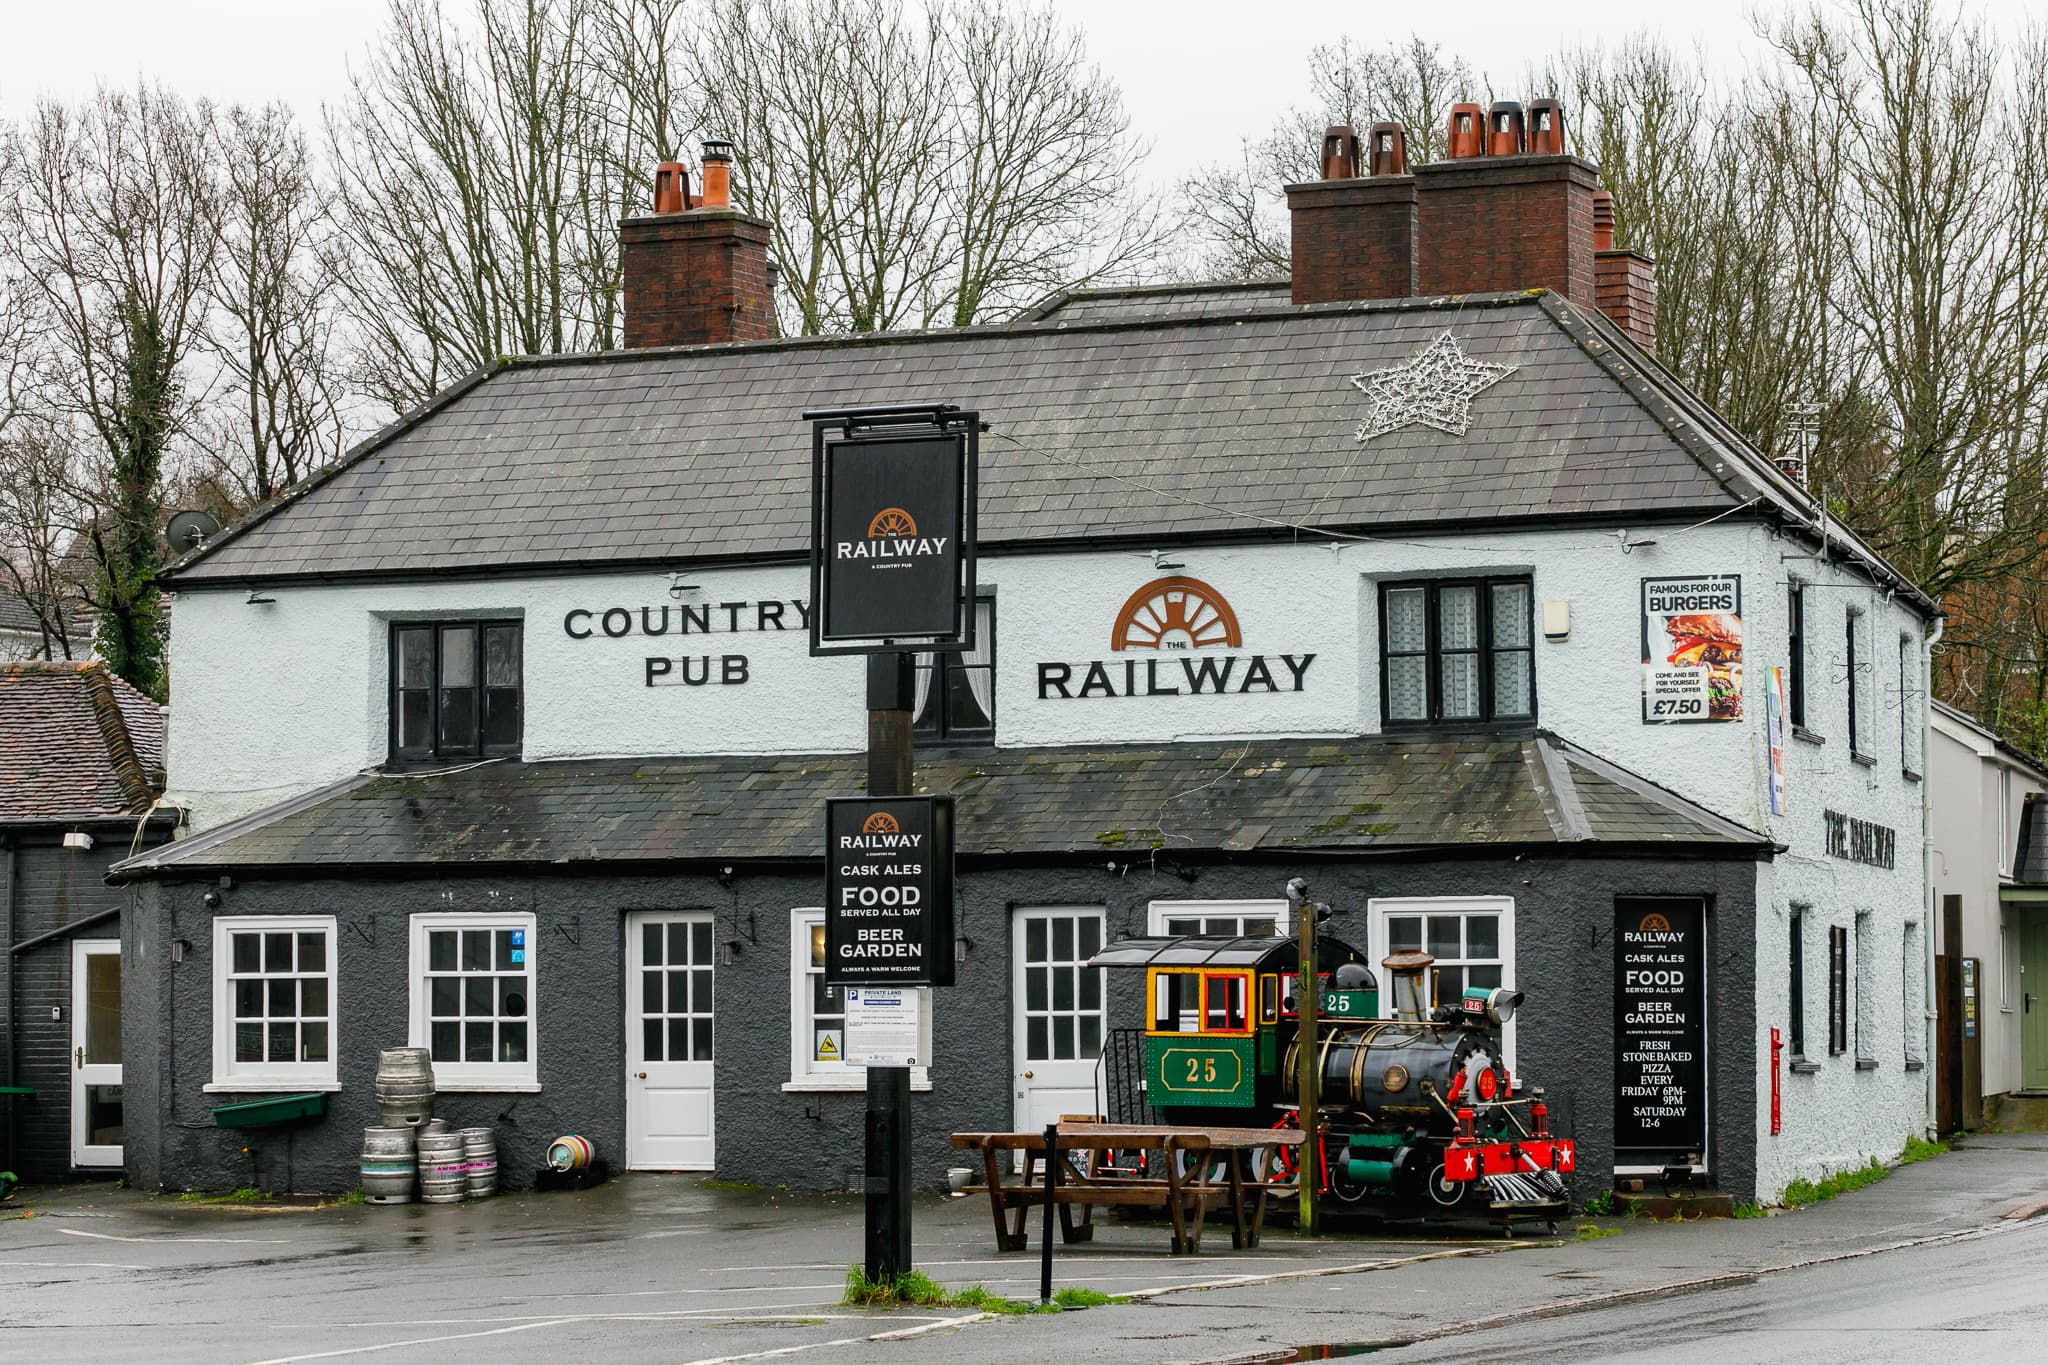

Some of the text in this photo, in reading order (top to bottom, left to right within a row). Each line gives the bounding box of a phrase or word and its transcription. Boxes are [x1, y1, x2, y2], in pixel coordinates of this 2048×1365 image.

[837, 537, 948, 559] RAILWAY
[1650, 583, 1732, 594] FAMOUS FOR OUR
[1650, 595, 1732, 612] BURGERS
[564, 600, 810, 639] COUNTRY
[1166, 641, 1186, 649] THE
[645, 655, 749, 687] PUB
[1037, 654, 1317, 699] RAILWAY
[1653, 699, 1701, 715] £7.50
[840, 834, 922, 848] RAILWAY
[841, 864, 922, 876] CASK ALES
[842, 886, 920, 906] FOOD
[858, 929, 904, 941] BEER
[1624, 932, 1684, 942] RAILWAY
[840, 944, 922, 958] GARDEN
[1625, 954, 1684, 962] CASK ALES
[1626, 971, 1684, 985] FOOD
[849, 990, 857, 1000] P
[1328, 995, 1350, 1012] 25
[1638, 1002, 1672, 1012] BEER
[1624, 1014, 1685, 1023] GARDEN
[1640, 1041, 1670, 1050] FRESH
[1186, 1058, 1216, 1082] 25
[1642, 1064, 1672, 1073] PIZZA
[1482, 1076, 1492, 1090] 25
[1640, 1076, 1674, 1084] EVERY
[1622, 1086, 1686, 1096] FRIDAY 6PM-
[1663, 1096, 1683, 1105] 9PM
[1634, 1107, 1687, 1116] SATURDAY
[1641, 1118, 1660, 1128] 12-6
